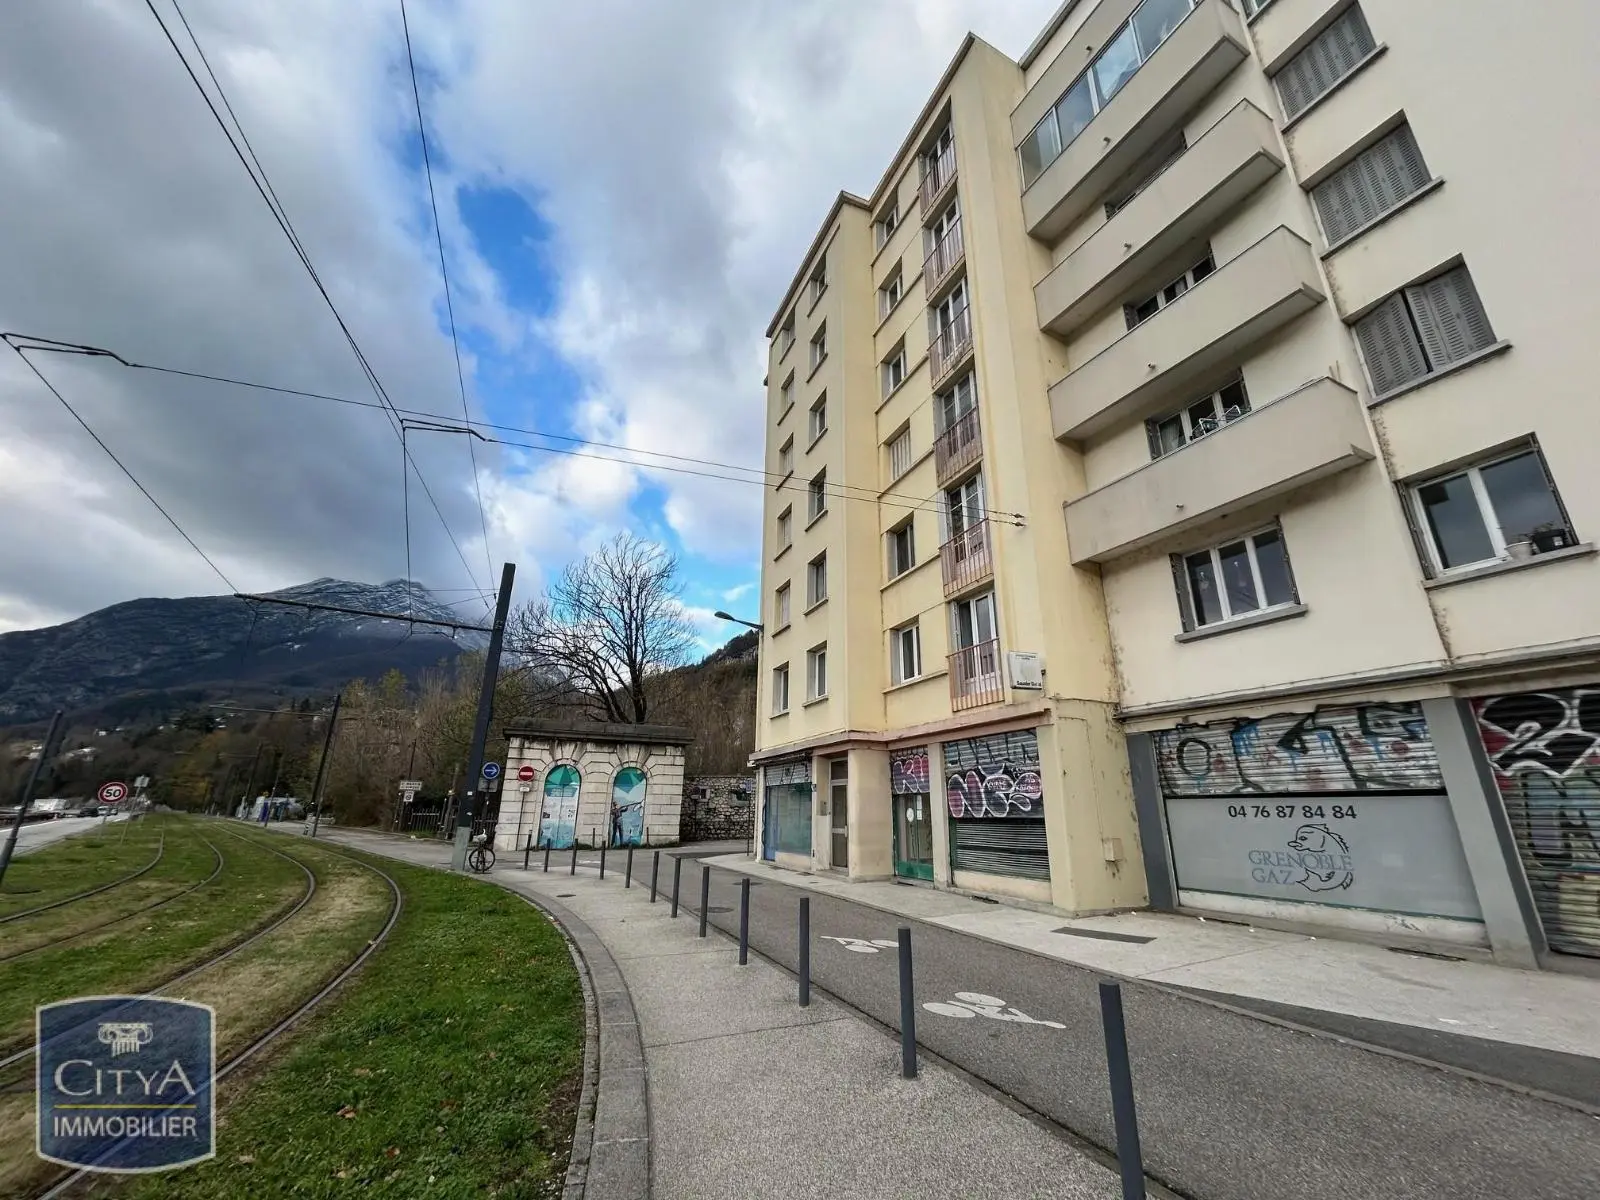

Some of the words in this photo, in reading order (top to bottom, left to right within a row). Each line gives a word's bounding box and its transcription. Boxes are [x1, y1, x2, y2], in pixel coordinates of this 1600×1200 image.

[105, 789, 120, 797] 50
[1228, 805, 1247, 818] 04
[1251, 805, 1271, 818] 76
[1276, 805, 1296, 818] 87
[1302, 805, 1325, 819] 84
[1332, 805, 1357, 819] 84
[1248, 849, 1355, 871] GRENOBLE
[1251, 867, 1296, 886] GAZ
